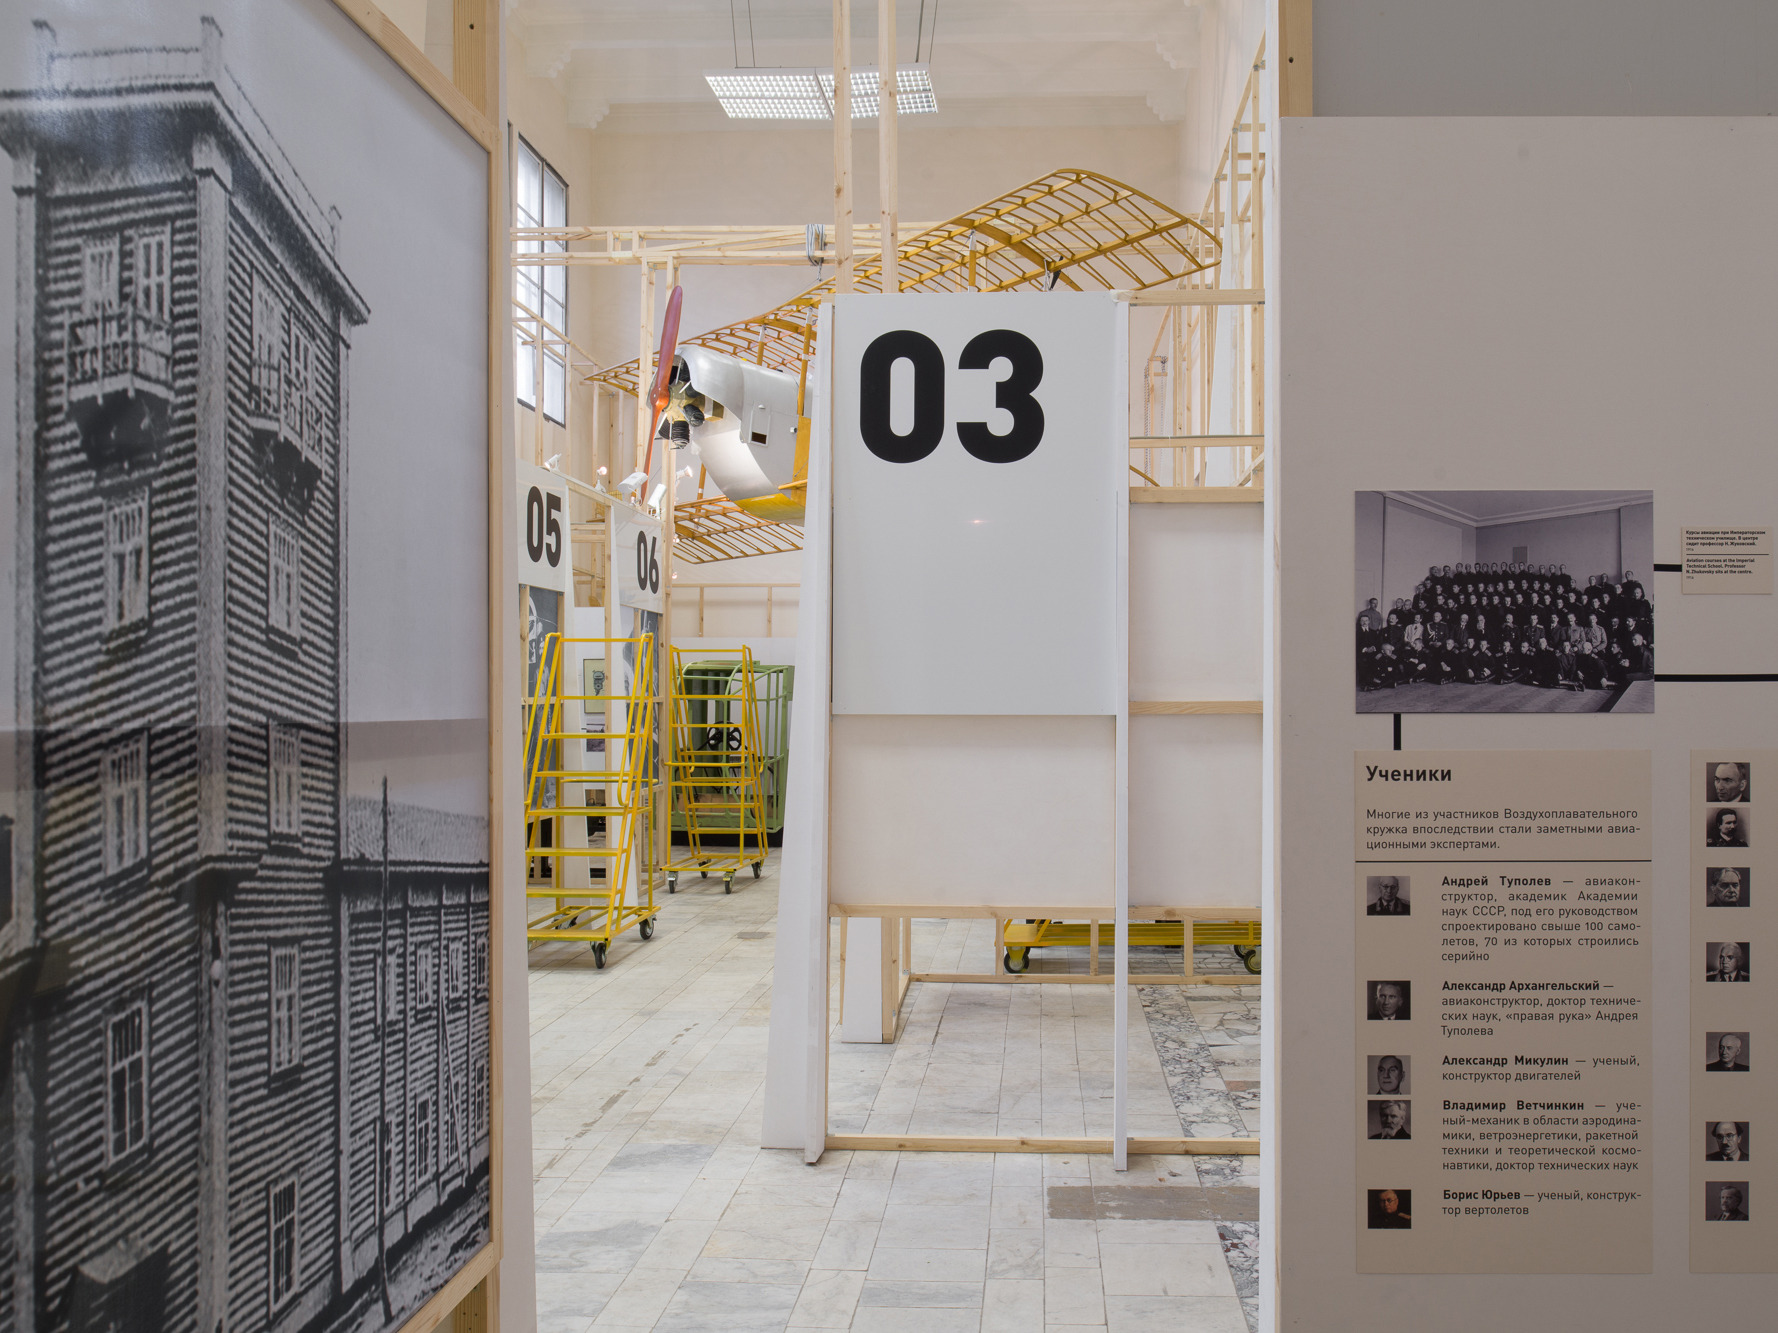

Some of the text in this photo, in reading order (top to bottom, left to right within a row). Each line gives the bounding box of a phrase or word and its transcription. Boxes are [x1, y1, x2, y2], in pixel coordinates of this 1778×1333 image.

[860, 328, 1045, 464] 03
[526, 485, 562, 568] 05
[636, 530, 660, 595] 06
[1365, 765, 1452, 782] Ученики
[1366, 808, 1638, 822] Многие из участников Воздухоплавательного
[1366, 825, 1641, 837] кружка впоследствии стали заметными авиа-
[1366, 840, 1500, 852] ционными экспертами.
[1441, 875, 1488, 889] Андрей
[1499, 875, 1552, 889] Туполев
[1584, 877, 1641, 886] авиакон-
[1441, 890, 1638, 904] структор, академик Академии
[1442, 905, 1638, 919] наук СССР, под его руководством
[1441, 921, 1641, 934] спроектировано свыше 100 само-
[1441, 936, 1639, 948] летов, 70 из которых строились
[1441, 950, 1490, 964] серийно
[1442, 980, 1506, 993] Александр
[1508, 980, 1600, 993] Архангельский
[1441, 997, 1641, 1009] авиаконструктор, доктор техниче-
[1441, 1010, 1638, 1024] ских наук, «правая рука» Андрея
[1440, 1024, 1494, 1038] Туполева
[1442, 1054, 1508, 1068] Александр
[1514, 1054, 1569, 1068] Микулин
[1592, 1054, 1640, 1068] ученый,
[1442, 1070, 1581, 1084] конструктор двигателей
[1443, 1099, 1506, 1113] Владимир
[1516, 1099, 1584, 1111] Ветчинкин
[1615, 1102, 1642, 1113] уче-
[1442, 1114, 1642, 1128] ный-механик в области аэродина-
[1442, 1129, 1638, 1143] мики, ветроэнергетики, ракетной
[1441, 1144, 1642, 1158] техники и теоретической космо-
[1442, 1162, 1639, 1173] навтики, доктор технических наук
[1443, 1189, 1479, 1202] Борис
[1481, 1189, 1521, 1202] Юрьев
[1537, 1189, 1584, 1203] ученый,
[1586, 1191, 1642, 1203] конструк-
[1441, 1206, 1530, 1218] тор вертолетов
